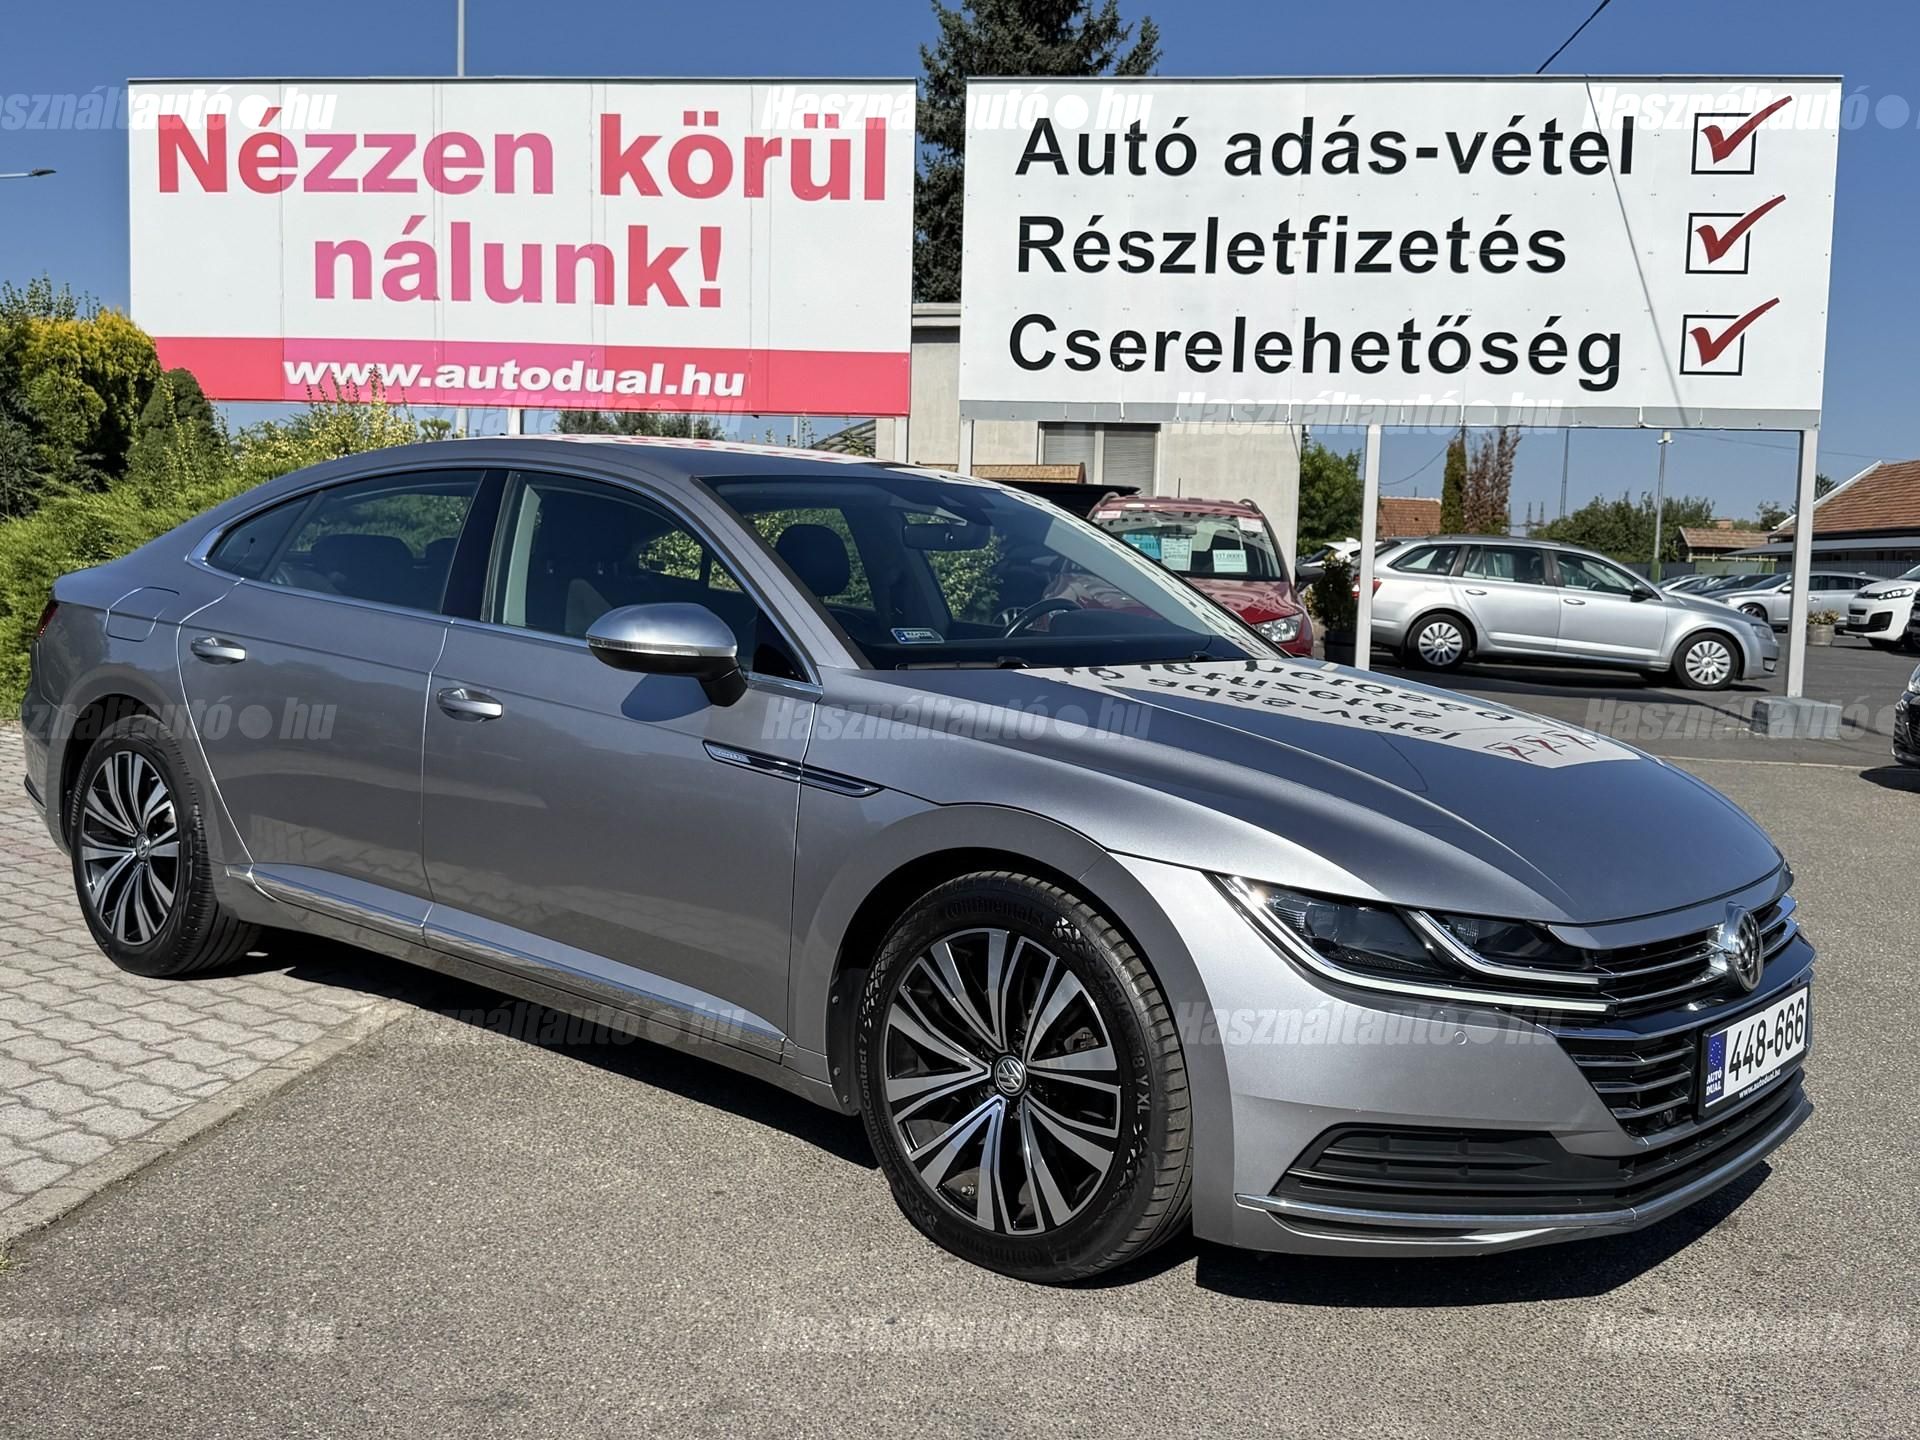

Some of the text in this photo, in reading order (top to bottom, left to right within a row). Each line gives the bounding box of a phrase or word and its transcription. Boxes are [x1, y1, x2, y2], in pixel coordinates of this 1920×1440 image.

[158, 106, 886, 201] Nézzen körül
[1014, 112, 1635, 177] Autó adás-vétel
[314, 215, 723, 308] nálunk!
[1018, 212, 1567, 275] Részletfizetés
[284, 358, 745, 398] www.autodual.hu
[1009, 313, 1622, 392] Cserelehetőség
[1728, 997, 1805, 1082] 448-666
[1706, 1067, 1722, 1084] AUTÓ
[1706, 1082, 1722, 1096] DUAL
